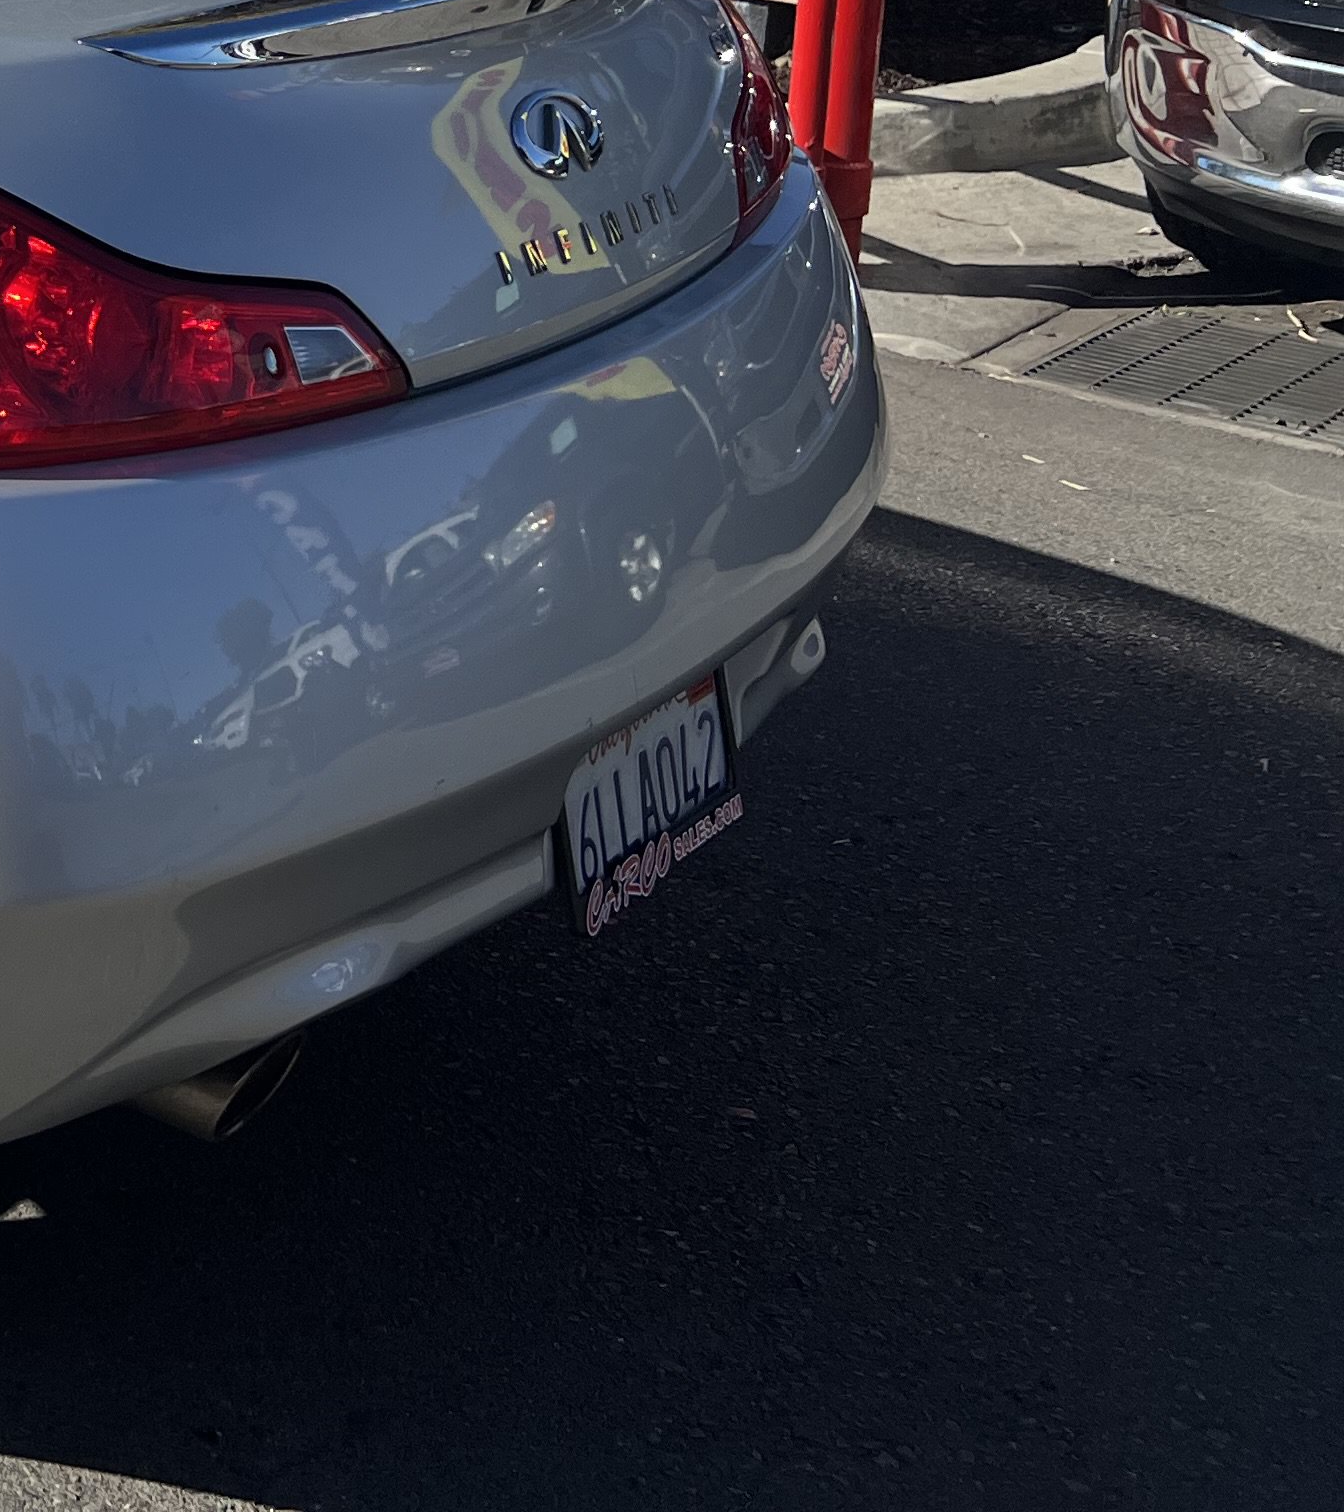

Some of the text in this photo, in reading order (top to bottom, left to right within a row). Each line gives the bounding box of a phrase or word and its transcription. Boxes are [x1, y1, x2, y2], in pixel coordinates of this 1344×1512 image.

[495, 184, 679, 285] INFINITI
[586, 793, 744, 937] CARCO SALES.COM
